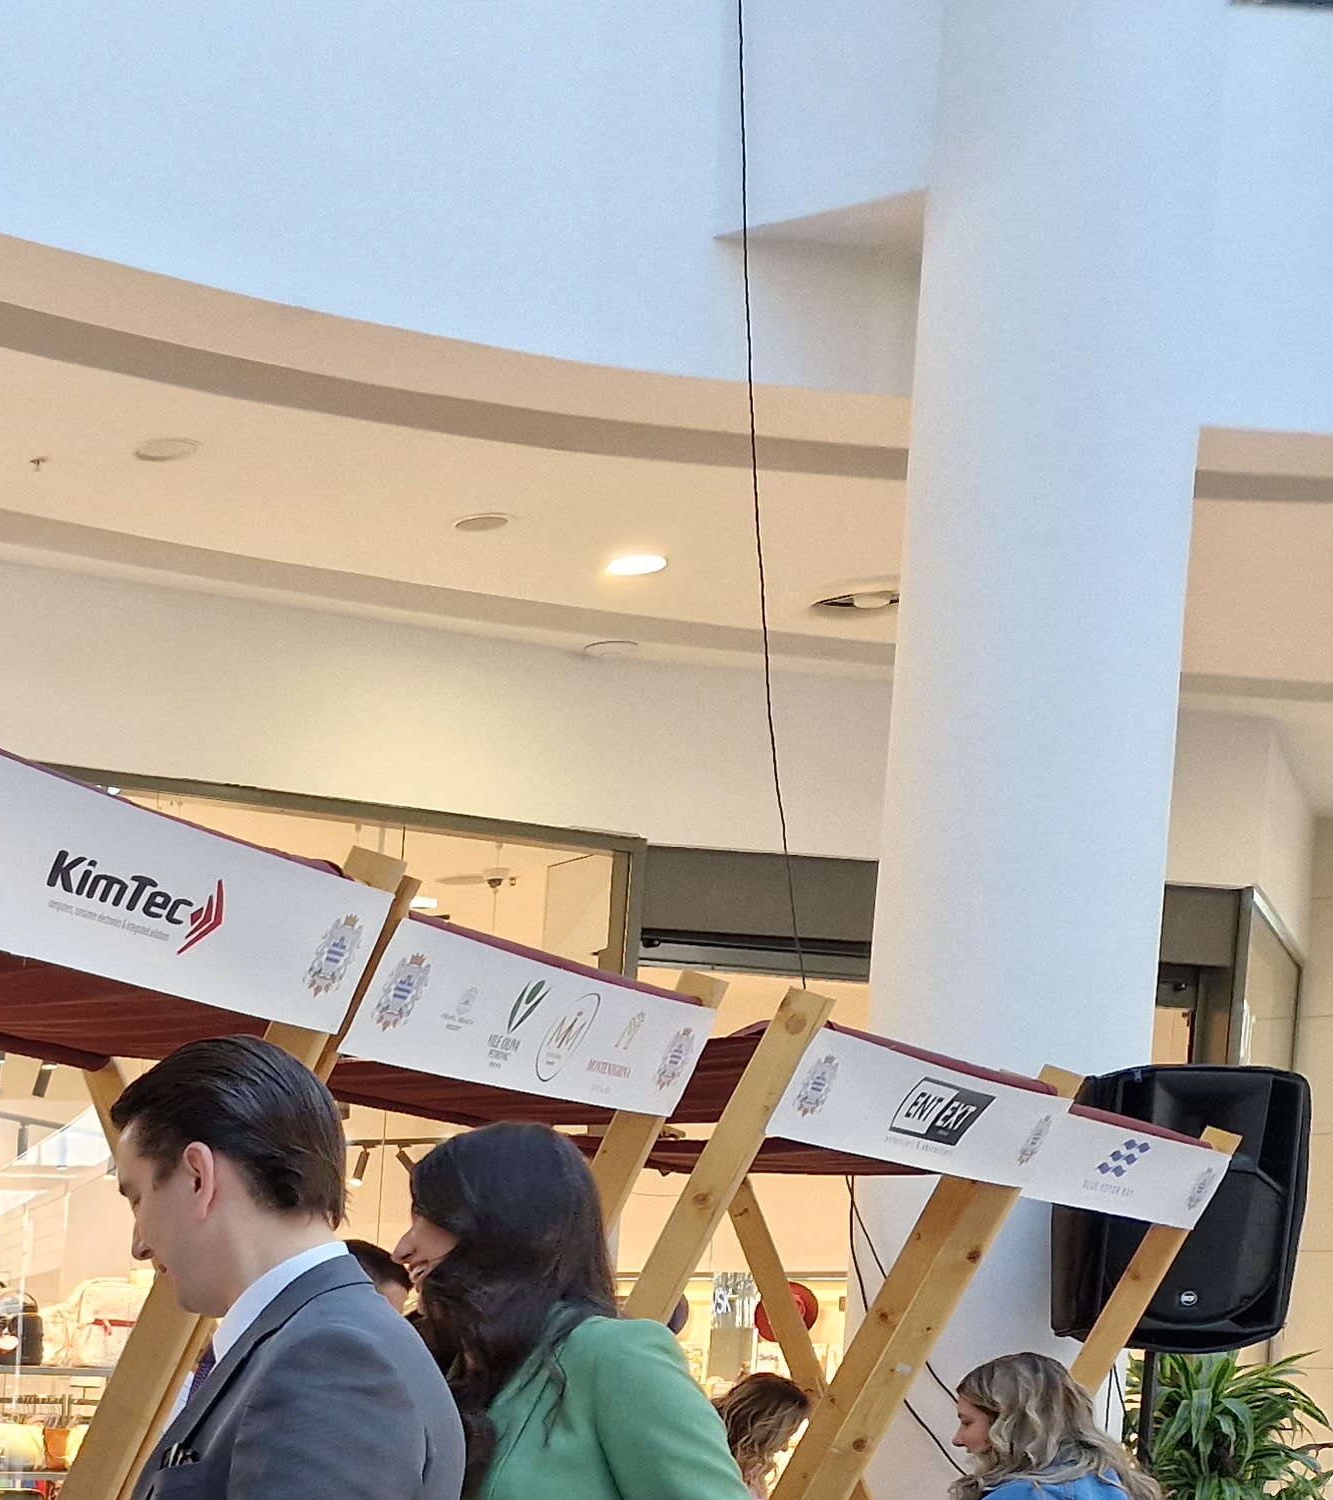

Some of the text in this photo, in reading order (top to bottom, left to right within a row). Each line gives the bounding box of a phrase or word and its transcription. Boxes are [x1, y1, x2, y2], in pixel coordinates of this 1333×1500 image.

[46, 849, 194, 925] KimTec
[904, 1092, 977, 1130] ENT EXT
